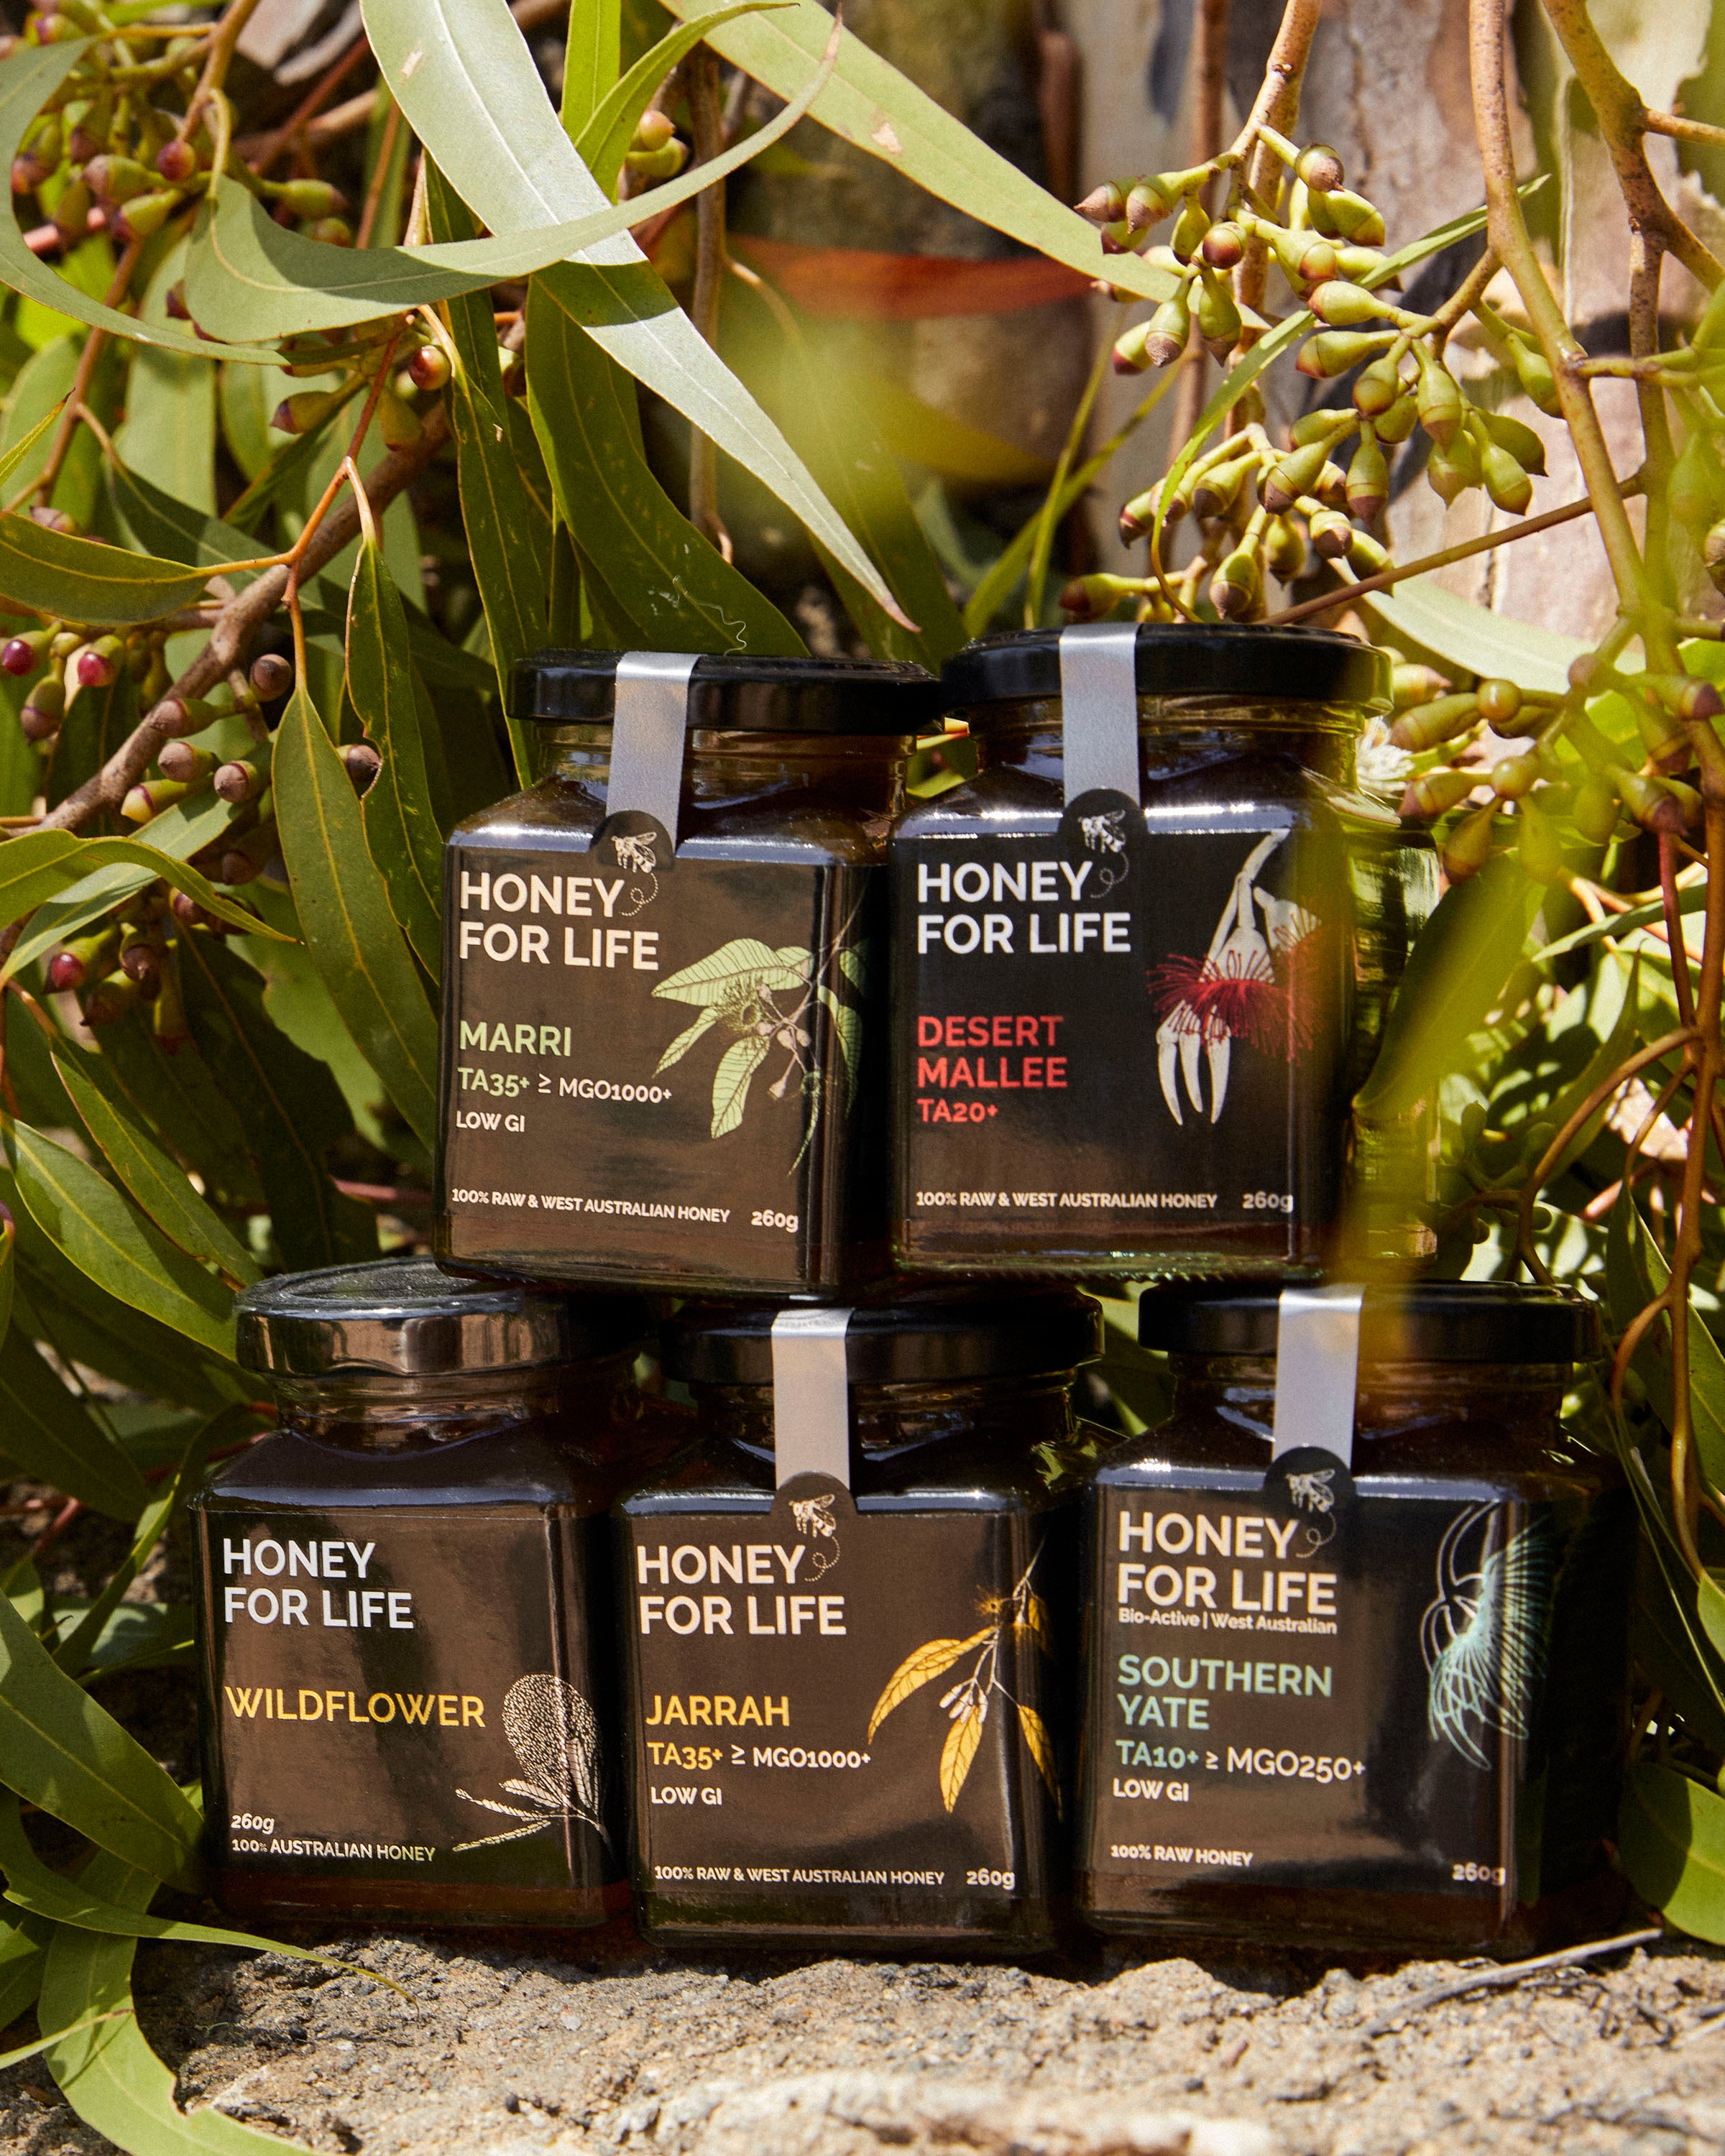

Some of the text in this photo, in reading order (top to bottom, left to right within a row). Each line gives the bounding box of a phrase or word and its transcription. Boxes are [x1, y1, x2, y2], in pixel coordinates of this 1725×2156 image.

[459, 871, 625, 917] HONEY
[918, 862, 1092, 902] HONEY
[459, 921, 659, 970] FOR LIFE
[917, 913, 1131, 954] FOR LIFE
[459, 1021, 571, 1056] MARRI
[917, 1016, 1064, 1047] DESERT
[458, 1067, 530, 1097] TA35+
[559, 1079, 672, 1104] MGO1000+
[917, 1057, 1068, 1089] MALLEE
[456, 1110, 525, 1132] LOW GI
[917, 1100, 998, 1123] TA20+
[451, 1188, 799, 1233] 100% RAW & WEST AUSTRALIAN HONEY 260g
[916, 1192, 1293, 1213] 100% RAW & WEST AUSTRALIAN HONEY 260g
[1118, 1511, 1299, 1558] HONEY
[224, 1538, 375, 1579] HONEY
[636, 1545, 805, 1584] HONEY
[1117, 1564, 1337, 1616] FOR LIFE
[224, 1587, 414, 1629] FOR LIFE
[639, 1596, 847, 1635] FOR LIFE
[1118, 1608, 1200, 1628] Bio-Active
[1210, 1613, 1256, 1631] West
[1257, 1616, 1337, 1635] Australian
[1118, 1656, 1333, 1697] SOUTHERN
[225, 1686, 486, 1728] WILDFLOWER
[646, 1695, 790, 1726] JARRAH
[1117, 1694, 1210, 1730] YATE
[648, 1742, 723, 1770] TA35+
[753, 1748, 871, 1768] MGO1000+
[1115, 1740, 1199, 1769] TA10+
[1227, 1747, 1366, 1783] MGO250+
[650, 1787, 722, 1805] LOW GI
[1113, 1779, 1189, 1801] LOW GI
[231, 1812, 275, 1834] 260g
[231, 1838, 436, 1861] 100% AUSTRALIAN HONEY
[1110, 1845, 1253, 1866] 100% RAW HONEY
[654, 1866, 1015, 1889] 100% RAW & WEST AUSTRALIAN HONEY 260g
[1452, 1864, 1505, 1885] 260g
